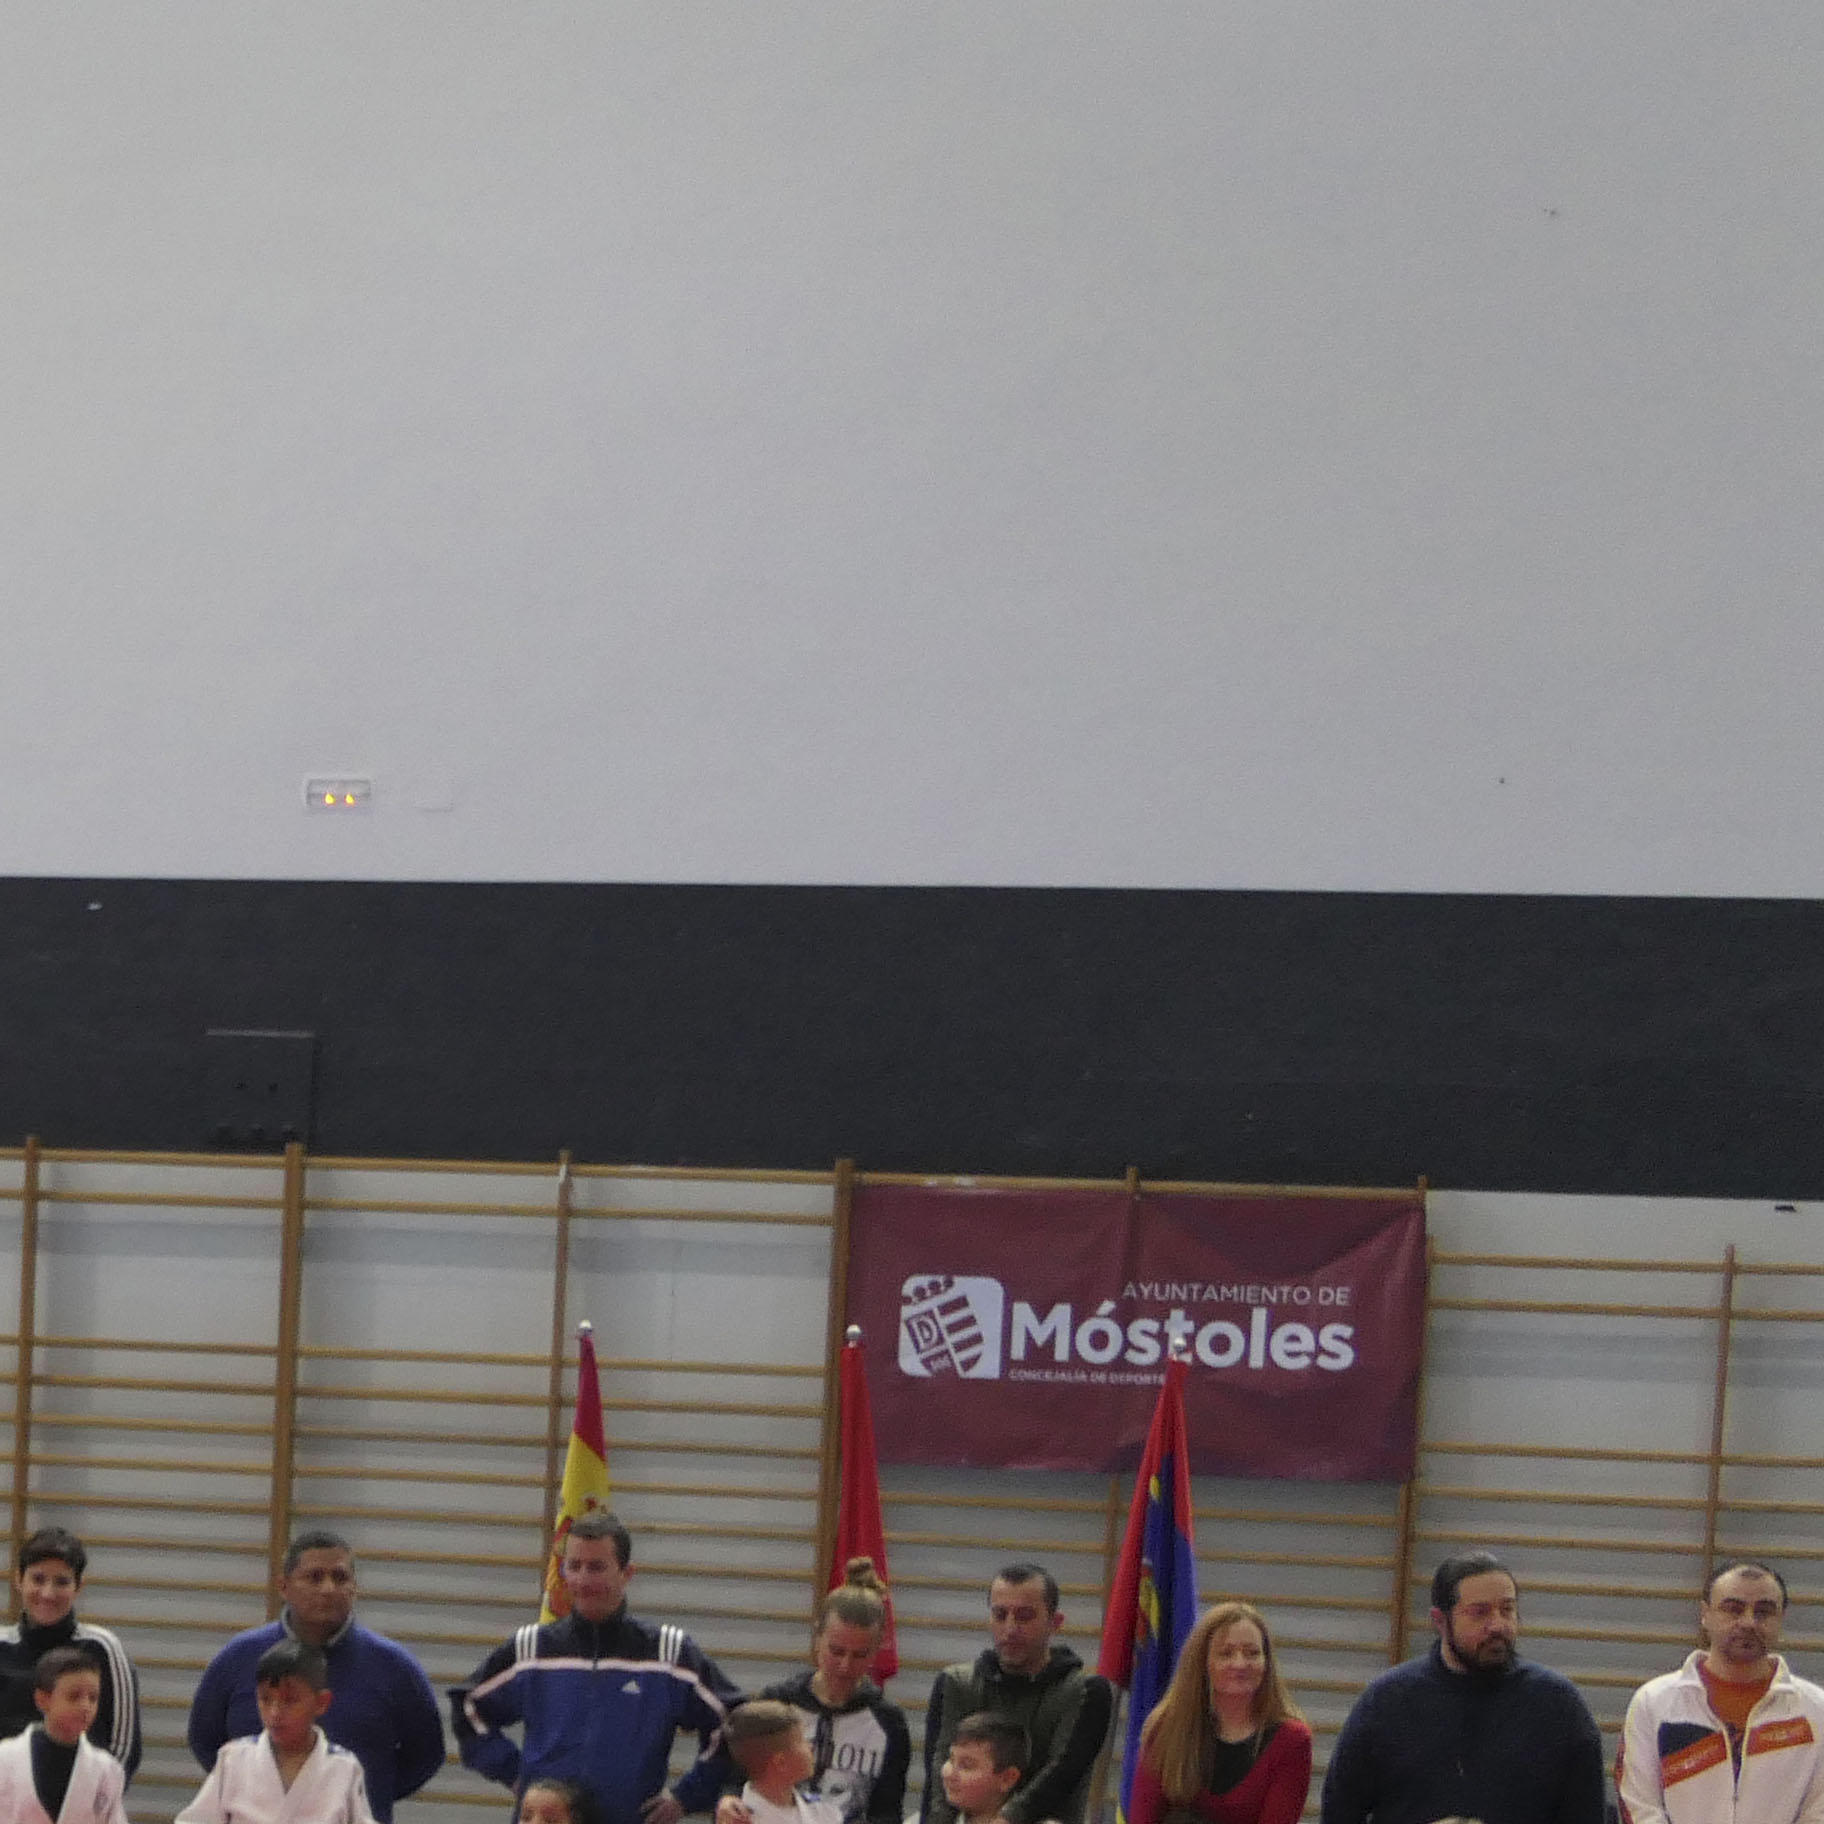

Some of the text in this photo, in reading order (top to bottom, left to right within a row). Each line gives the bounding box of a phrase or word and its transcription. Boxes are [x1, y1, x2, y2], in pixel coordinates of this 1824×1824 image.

[1122, 1281, 1351, 1306] AYUNTAMIENTO DE
[1009, 1300, 1355, 1371] Móstoles
